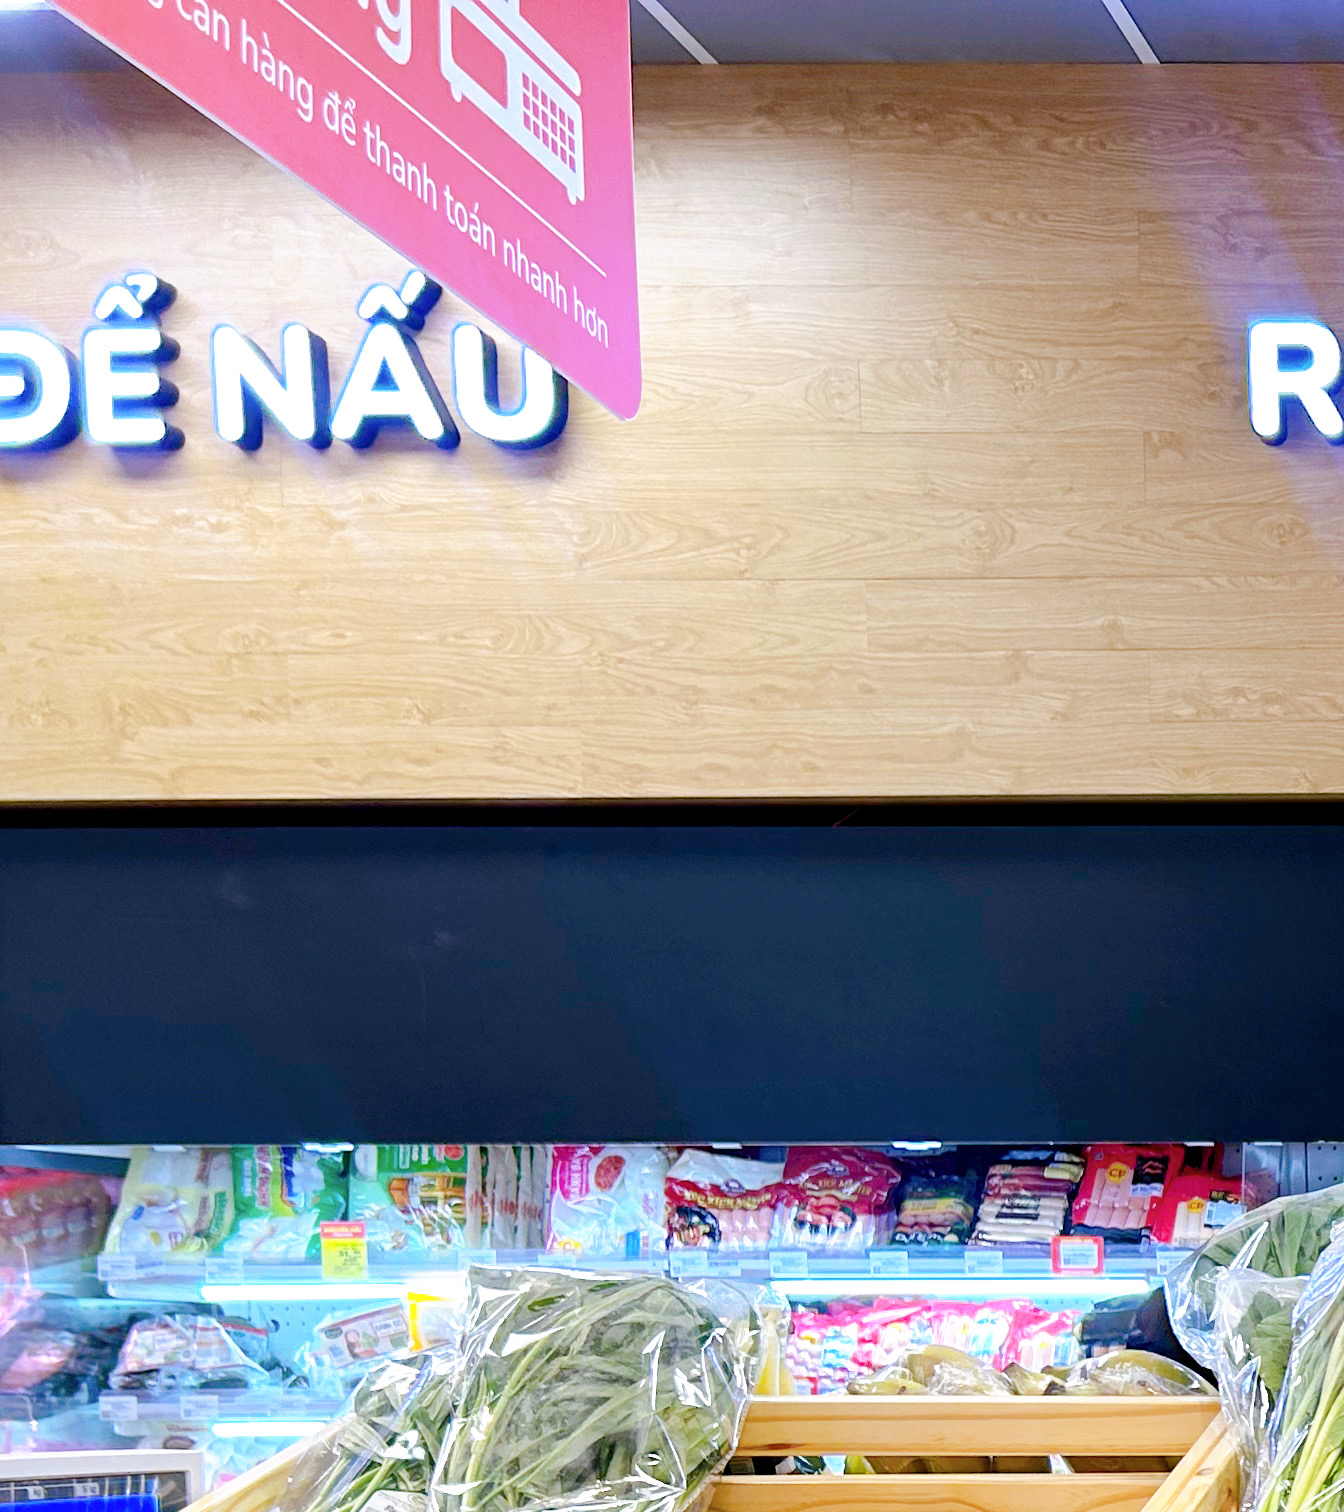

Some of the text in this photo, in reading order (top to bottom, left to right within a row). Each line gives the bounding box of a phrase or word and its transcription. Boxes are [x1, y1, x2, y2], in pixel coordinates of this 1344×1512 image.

[240, 18, 314, 123] hàng
[321, 89, 357, 146] để
[363, 120, 438, 211] thanh
[443, 190, 497, 257] toán
[502, 240, 567, 313] nhanh
[573, 294, 609, 349] hơn
[211, 270, 558, 444] NẤU
